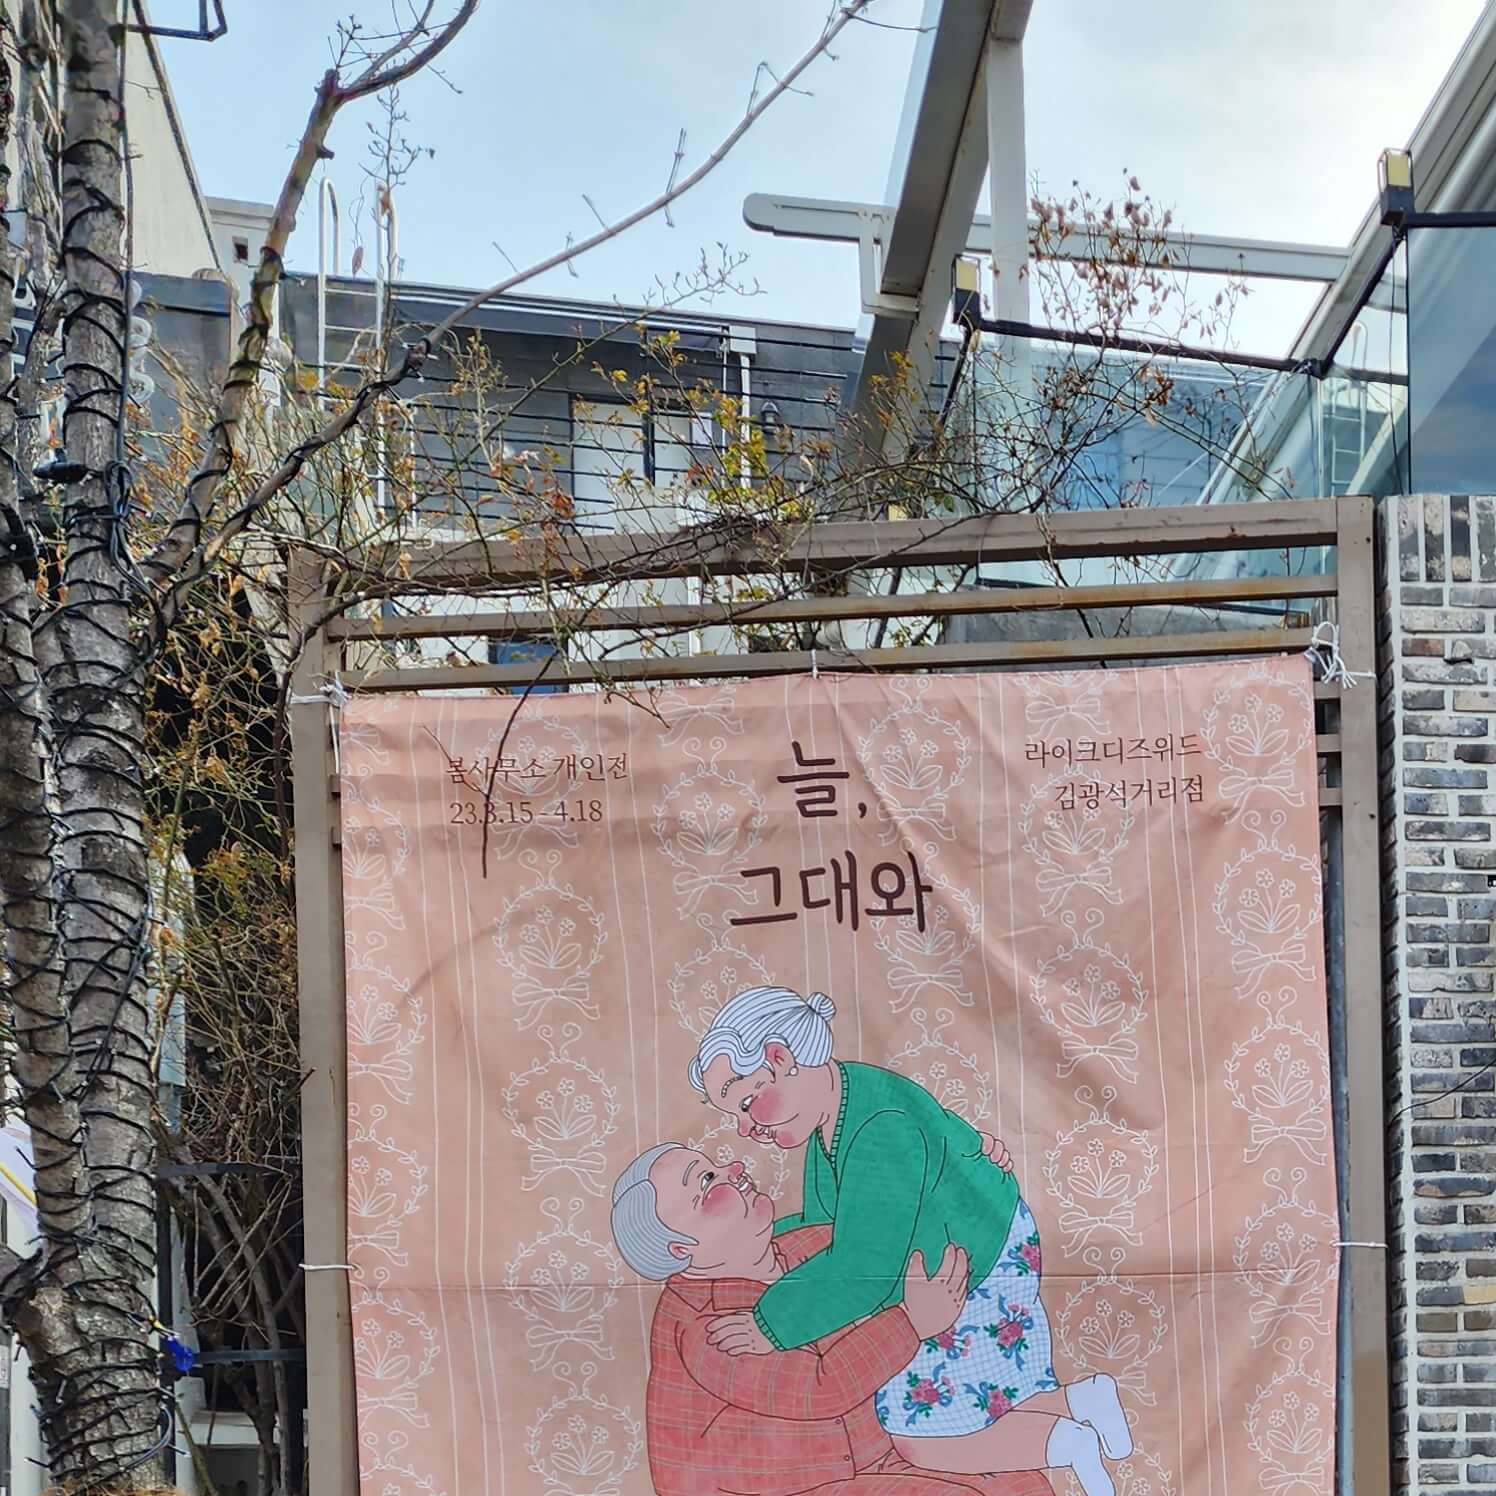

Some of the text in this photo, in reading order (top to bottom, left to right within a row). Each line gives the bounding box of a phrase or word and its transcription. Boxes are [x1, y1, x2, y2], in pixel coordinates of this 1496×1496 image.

[551, 752, 629, 782] 개인전
[1024, 732, 1203, 769] 라이크디즈위드
[777, 739, 868, 818] 늘,
[1054, 773, 1205, 811] 김광석거리점
[729, 849, 934, 933] 그대와
